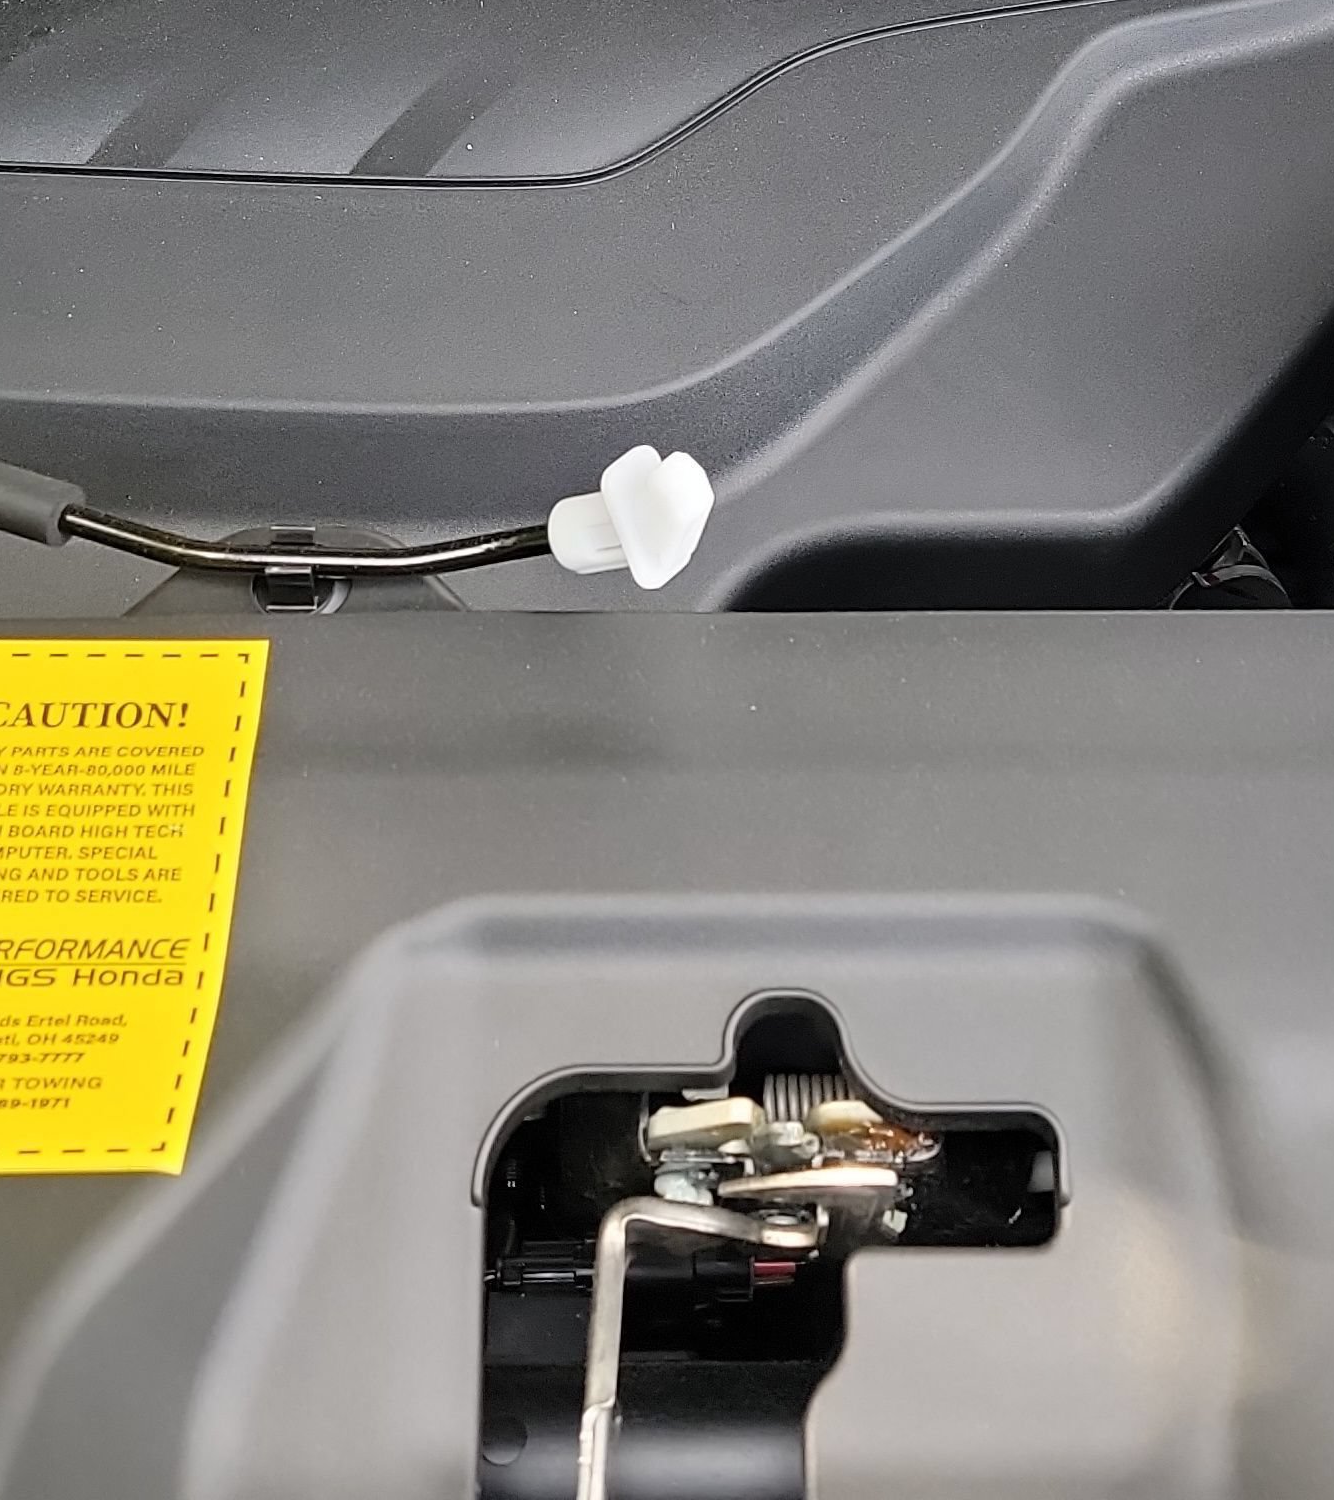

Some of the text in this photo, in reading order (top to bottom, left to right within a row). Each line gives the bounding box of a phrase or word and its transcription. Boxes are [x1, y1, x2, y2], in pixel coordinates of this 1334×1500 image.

[11, 746, 70, 758] PARTS
[74, 746, 113, 758] ARE
[116, 746, 205, 758] COVERED
[150, 763, 196, 776] MILE
[152, 783, 194, 796] THIS
[22, 804, 40, 817] IS
[46, 804, 141, 817] EQUIPPED
[148, 804, 196, 817] WITH
[8, 824, 75, 838] BOARD
[80, 824, 128, 838] HIGH
[135, 824, 184, 838] TECH
[78, 845, 158, 860] SPECIAL
[27, 867, 69, 882] AND
[76, 867, 139, 881] TOOLS
[143, 867, 182, 881] ARE
[45, 889, 70, 903] TO
[75, 889, 162, 903] SERVICE.
[73, 968, 184, 986] Honda
[26, 1014, 71, 1027] Ertel
[76, 1014, 128, 1028] Road,
[27, 1033, 57, 1046] OH
[12, 1077, 103, 1091] TOWING
